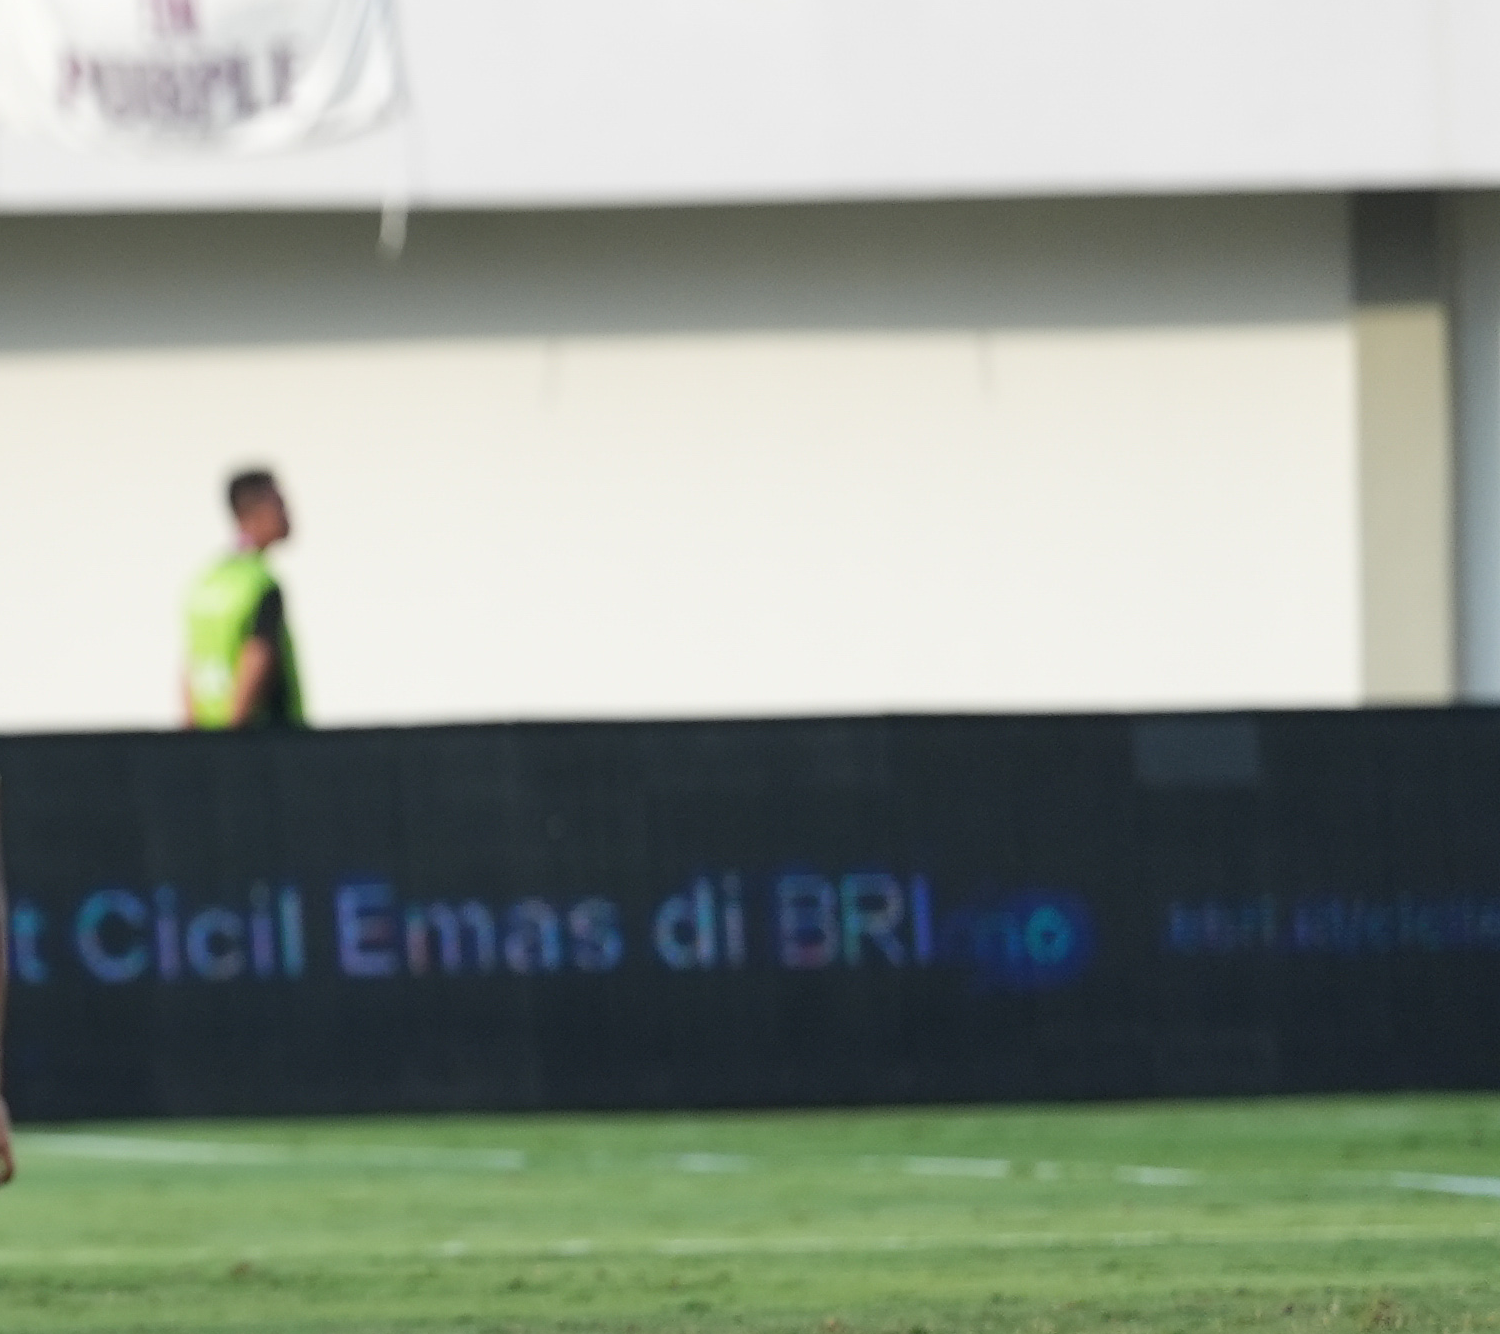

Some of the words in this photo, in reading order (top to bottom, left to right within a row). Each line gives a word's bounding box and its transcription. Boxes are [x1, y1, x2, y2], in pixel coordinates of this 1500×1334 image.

[73, 883, 306, 983] Cicil
[333, 881, 626, 977] Emas
[653, 870, 746, 970] di
